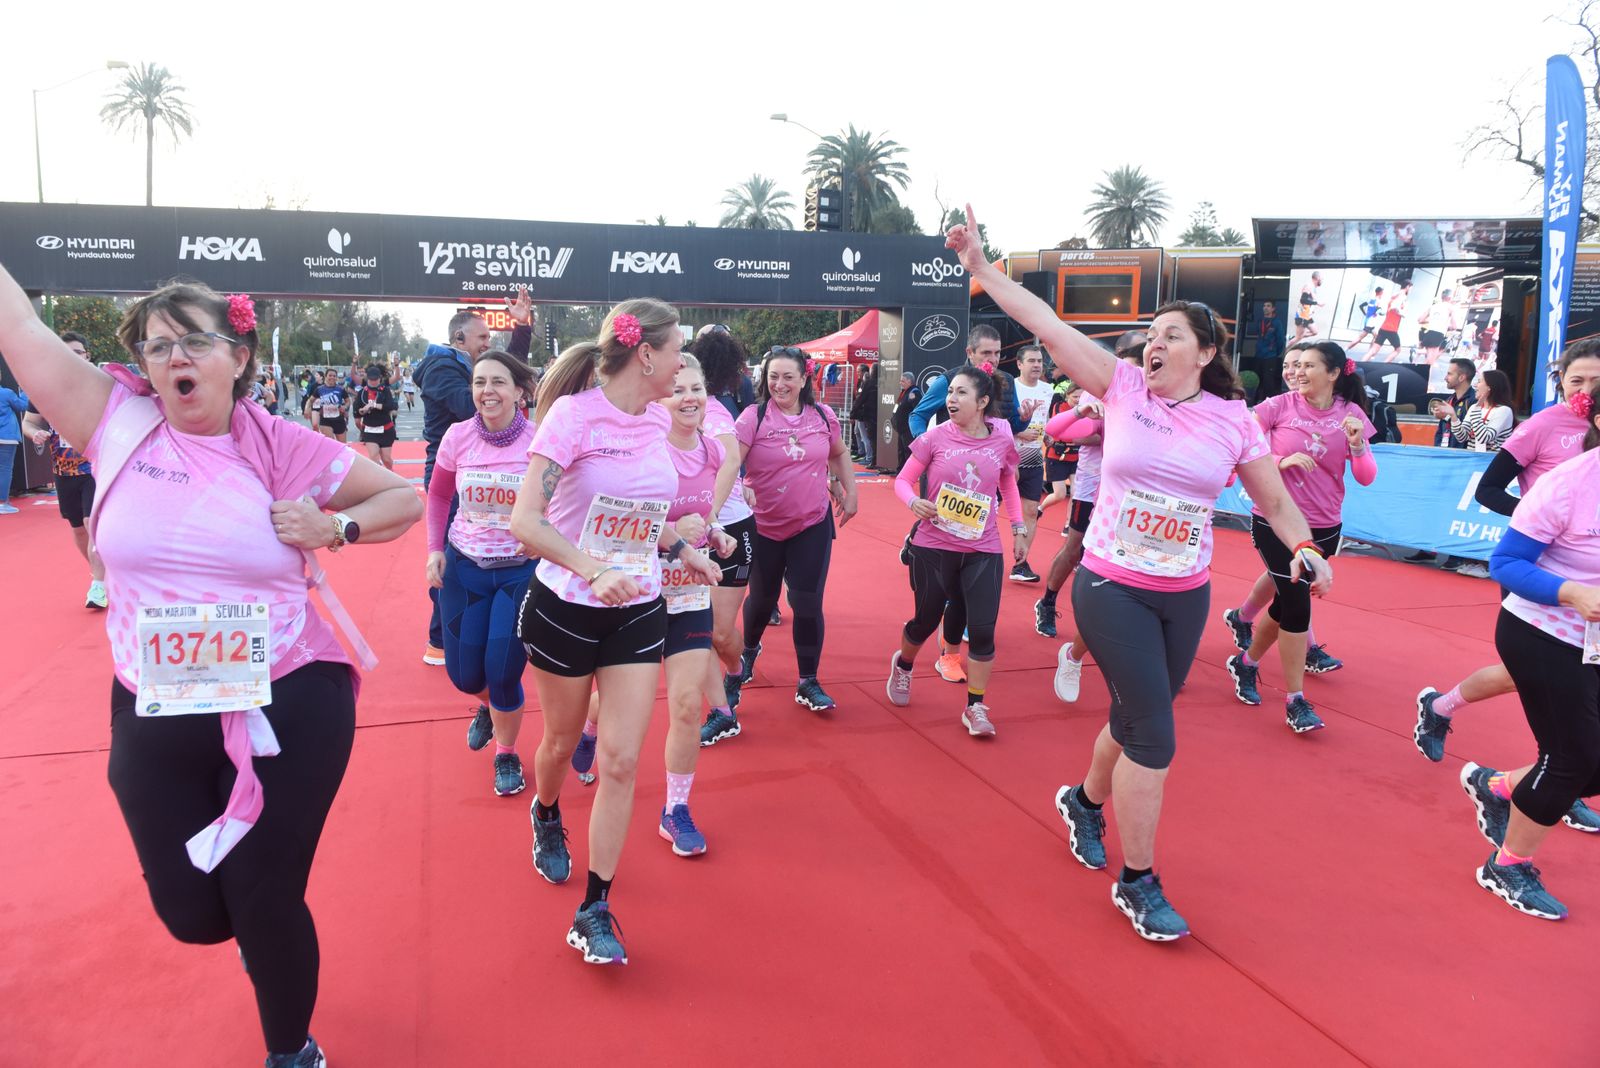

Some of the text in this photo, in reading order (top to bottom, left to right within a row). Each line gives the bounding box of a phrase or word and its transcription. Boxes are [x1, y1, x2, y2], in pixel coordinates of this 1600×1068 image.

[67, 237, 135, 249] HYUNDAI
[178, 236, 264, 262] HOKA
[447, 240, 551, 261] maratón
[67, 251, 135, 260] Hyundauto Motor
[610, 251, 682, 274] HOKA
[737, 259, 791, 271] HYUNDAI
[309, 271, 372, 280] Healthcare Partner
[475, 257, 552, 278] sevilla
[737, 271, 790, 280] Hyundauto Motor
[462, 281, 475, 290] 28
[826, 284, 858, 292] Healthcare
[1381, 373, 1399, 403] 1
[465, 485, 518, 506] 13709
[942, 494, 982, 519] 10067
[1176, 500, 1202, 514] SEVILLA
[594, 513, 652, 541] 13713
[1127, 507, 1192, 543] 13705
[1449, 519, 1481, 538] FLY
[742, 531, 753, 564] WONG
[215, 604, 252, 619] SEVILLA
[149, 630, 249, 665] 13712
